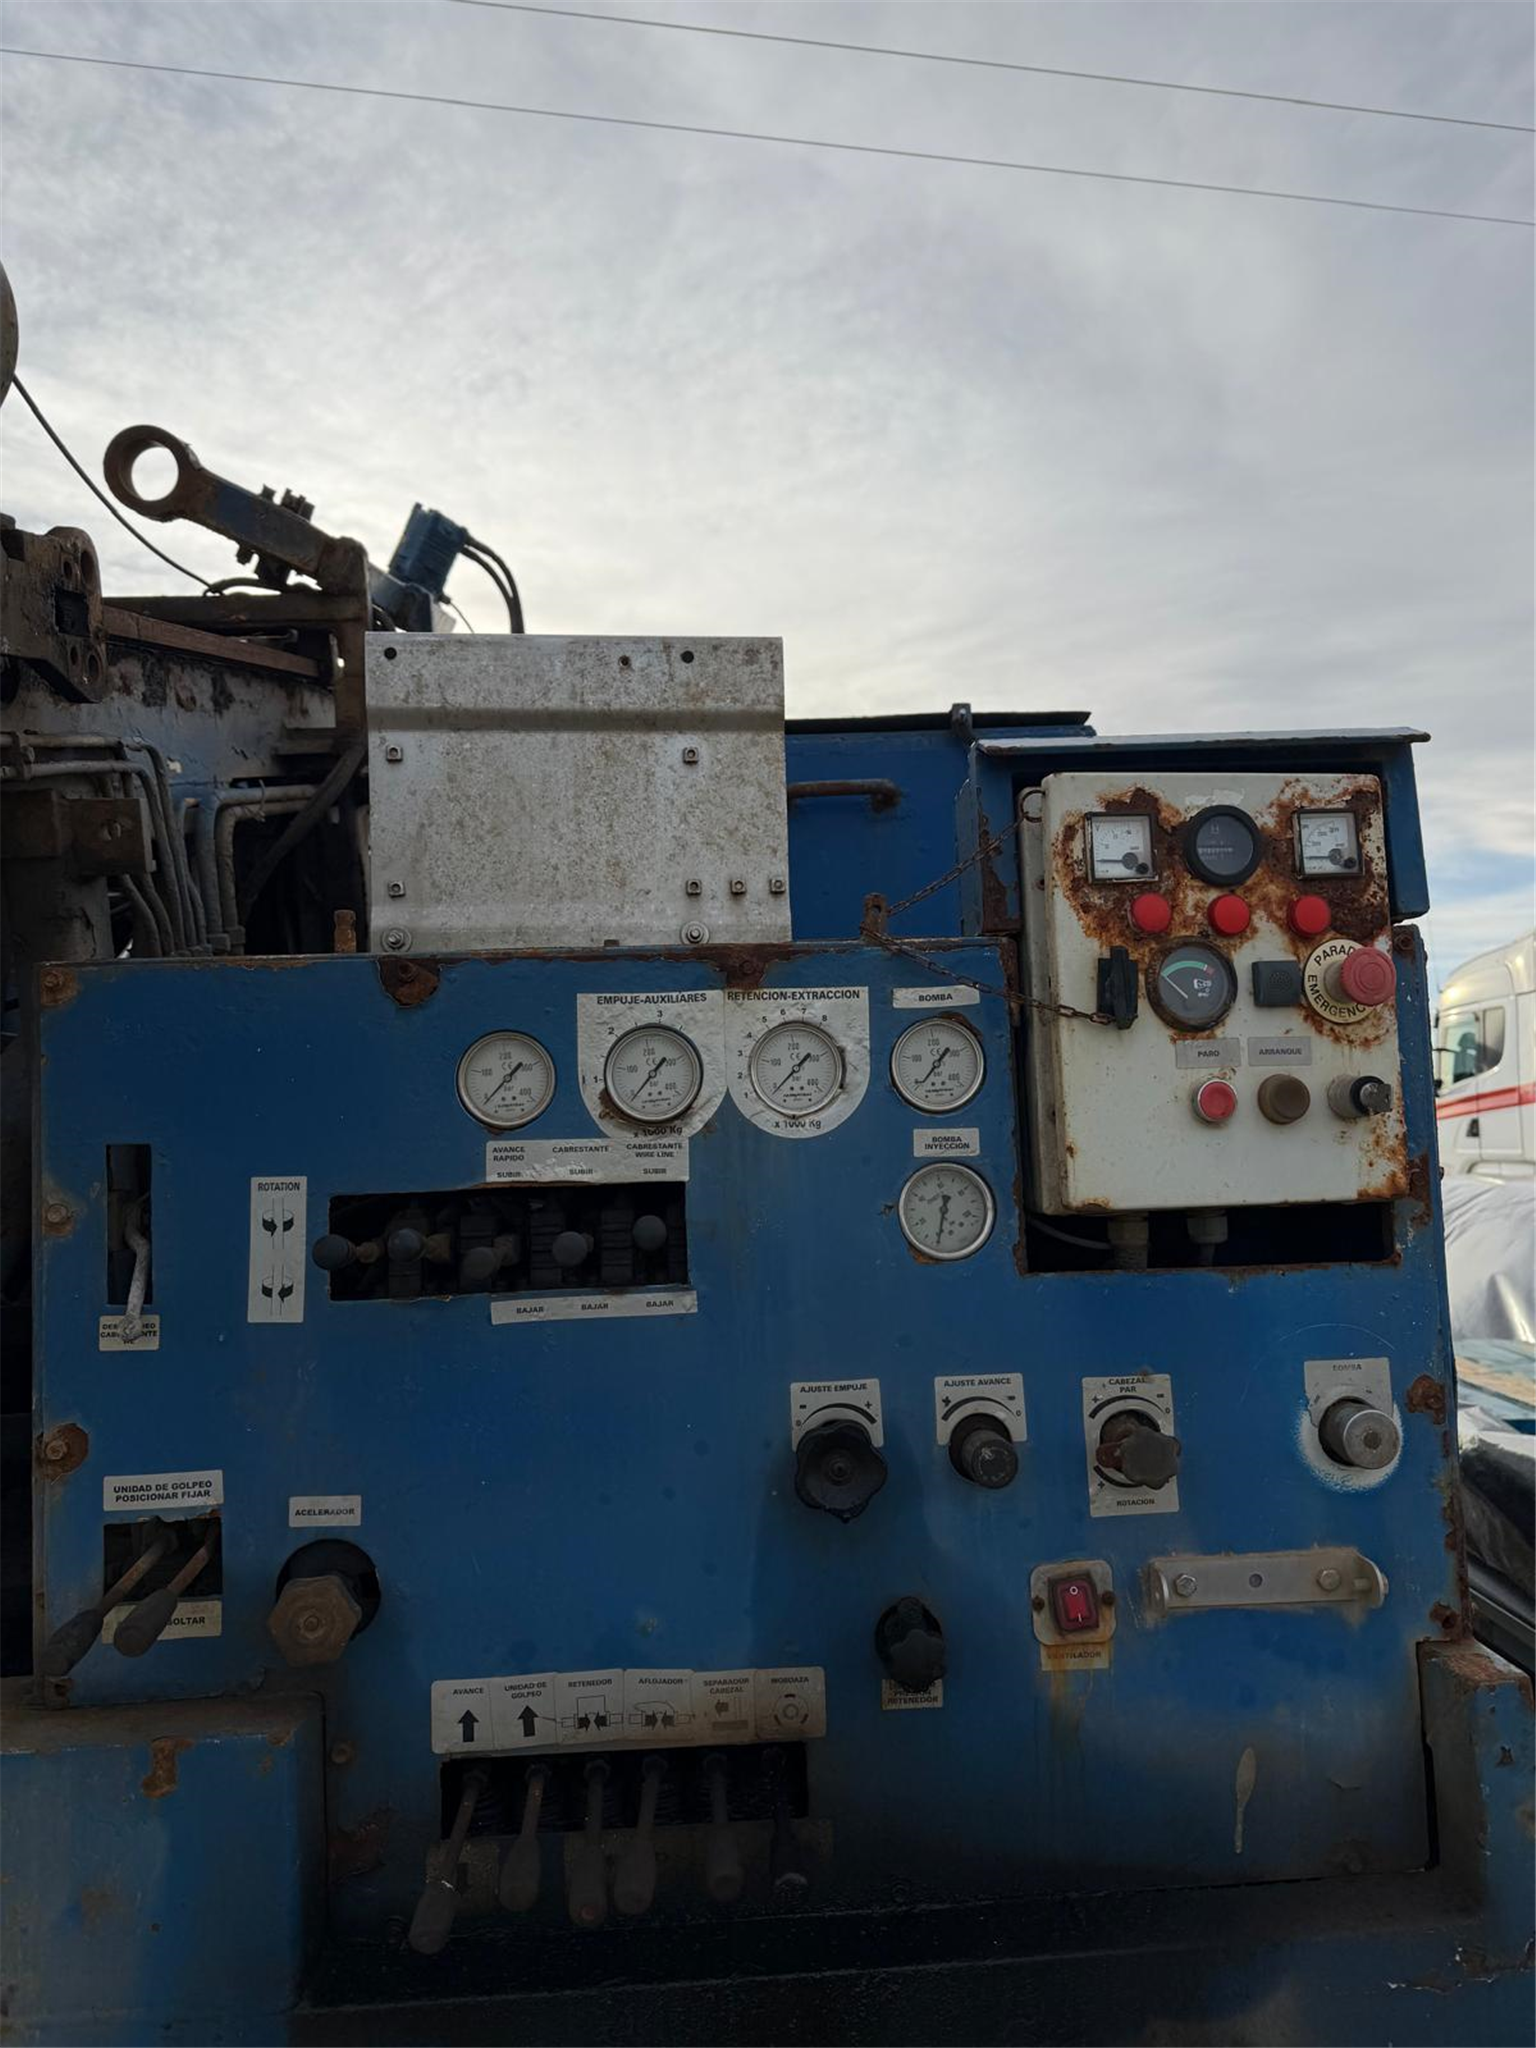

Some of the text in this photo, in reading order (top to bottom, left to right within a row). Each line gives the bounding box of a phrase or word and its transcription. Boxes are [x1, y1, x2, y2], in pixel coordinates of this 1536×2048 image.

[1313, 944, 1357, 967] PARAD
[727, 989, 861, 1002] RETENCION-EXTRACCION
[918, 993, 954, 1003] BOMBA
[1307, 974, 1367, 1018] EMERGENC
[657, 1010, 664, 1018] 3
[607, 1027, 615, 1035] 2
[1197, 1050, 1220, 1058] PARO
[1258, 1047, 1303, 1056] ARRANQUE
[809, 1118, 822, 1129] Kg
[669, 1125, 683, 1136] Kg
[932, 1135, 963, 1143] BOMBA
[492, 1146, 526, 1154] AVANCE
[552, 1145, 610, 1154] CABRESTANTE
[626, 1142, 683, 1151] CABRESTANTE
[925, 1142, 970, 1151] INYECCION
[493, 1154, 525, 1162] RAPIDO
[569, 1168, 594, 1176] SUBIR
[643, 1167, 668, 1175] SUBIR
[257, 1181, 301, 1192] ROTATION
[581, 1302, 609, 1311] BAJAR
[645, 1299, 675, 1308] BAJAR
[516, 1306, 545, 1315] BAJAR
[944, 1377, 1012, 1388] AJUSTE AVANCE
[1108, 1377, 1147, 1386] CABEZAL
[799, 1382, 868, 1394] AJUSTE EMPUJE
[1119, 1386, 1137, 1394] PAR
[113, 1480, 213, 1494] UNIDAD DE GOLPEO
[115, 1489, 211, 1503] POSICIONAR FIJAR
[1116, 1499, 1155, 1507] ROTACION
[504, 1681, 548, 1692] UNIDAD DE
[568, 1678, 613, 1688] RETENEDOR
[638, 1678, 684, 1686] AFLOJADOR
[703, 1677, 750, 1687] SEPARADOR
[452, 1687, 485, 1696] AVANCE
[511, 1690, 543, 1700] GOLPEO
